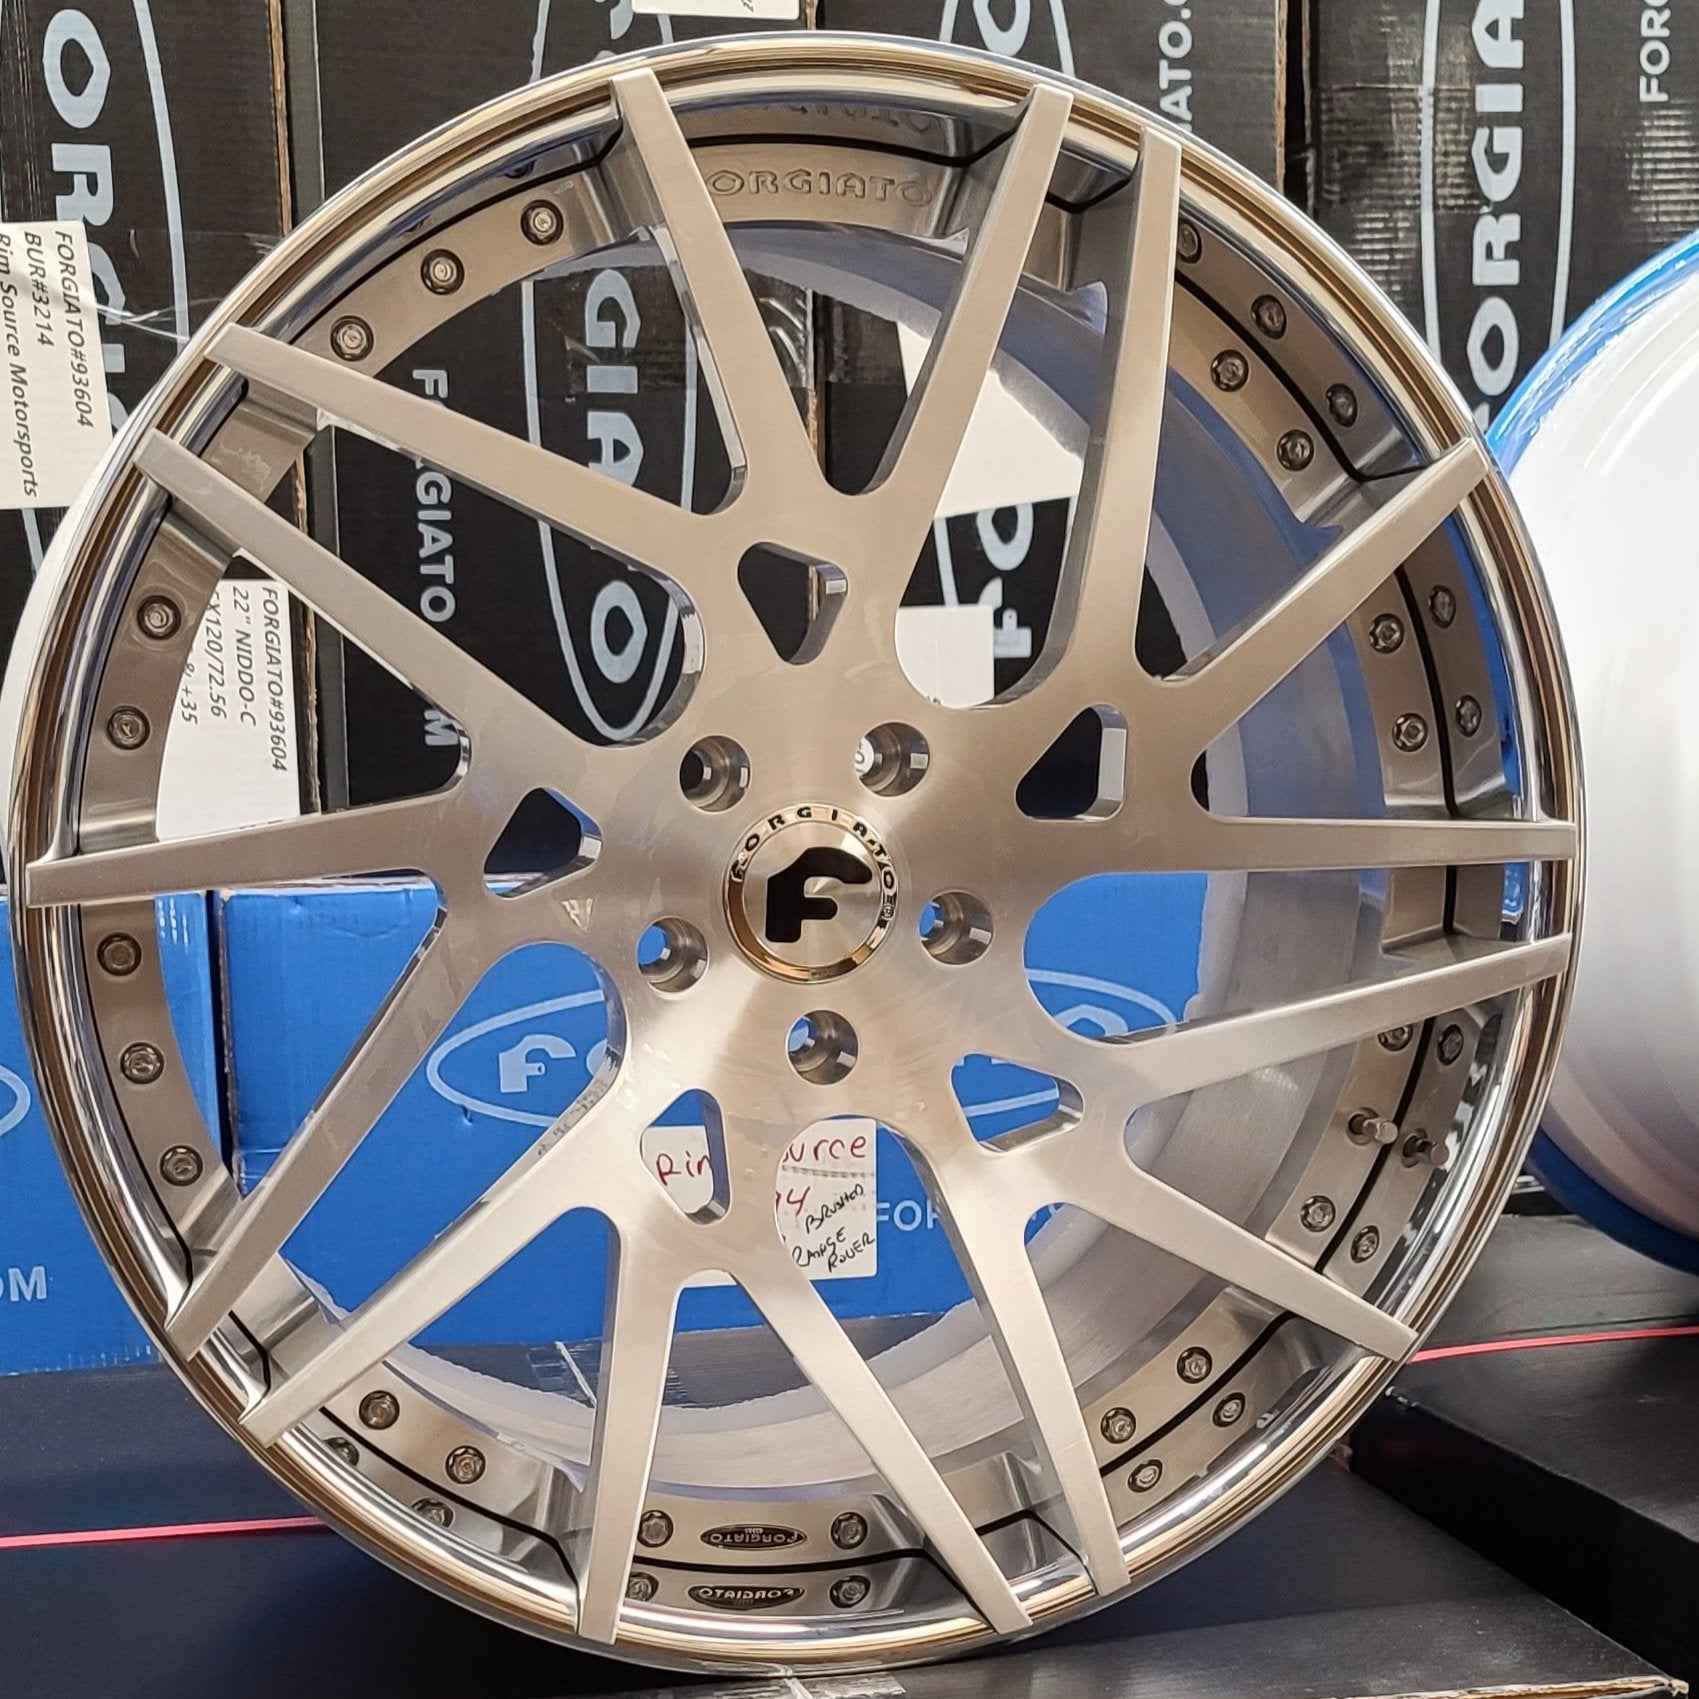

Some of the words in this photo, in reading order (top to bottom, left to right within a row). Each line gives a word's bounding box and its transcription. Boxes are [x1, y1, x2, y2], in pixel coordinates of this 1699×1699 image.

[1640, 0, 1671, 102] FOR
[706, 169, 934, 208] ORGIATO
[0, 281, 22, 356] Source
[24, 231, 54, 347] BUR#3214
[55, 230, 94, 428] FORGIATO#93604
[9, 363, 39, 497] Motorsports
[235, 629, 257, 726] NIDDO-C
[262, 586, 288, 772] FORGIATO#93604
